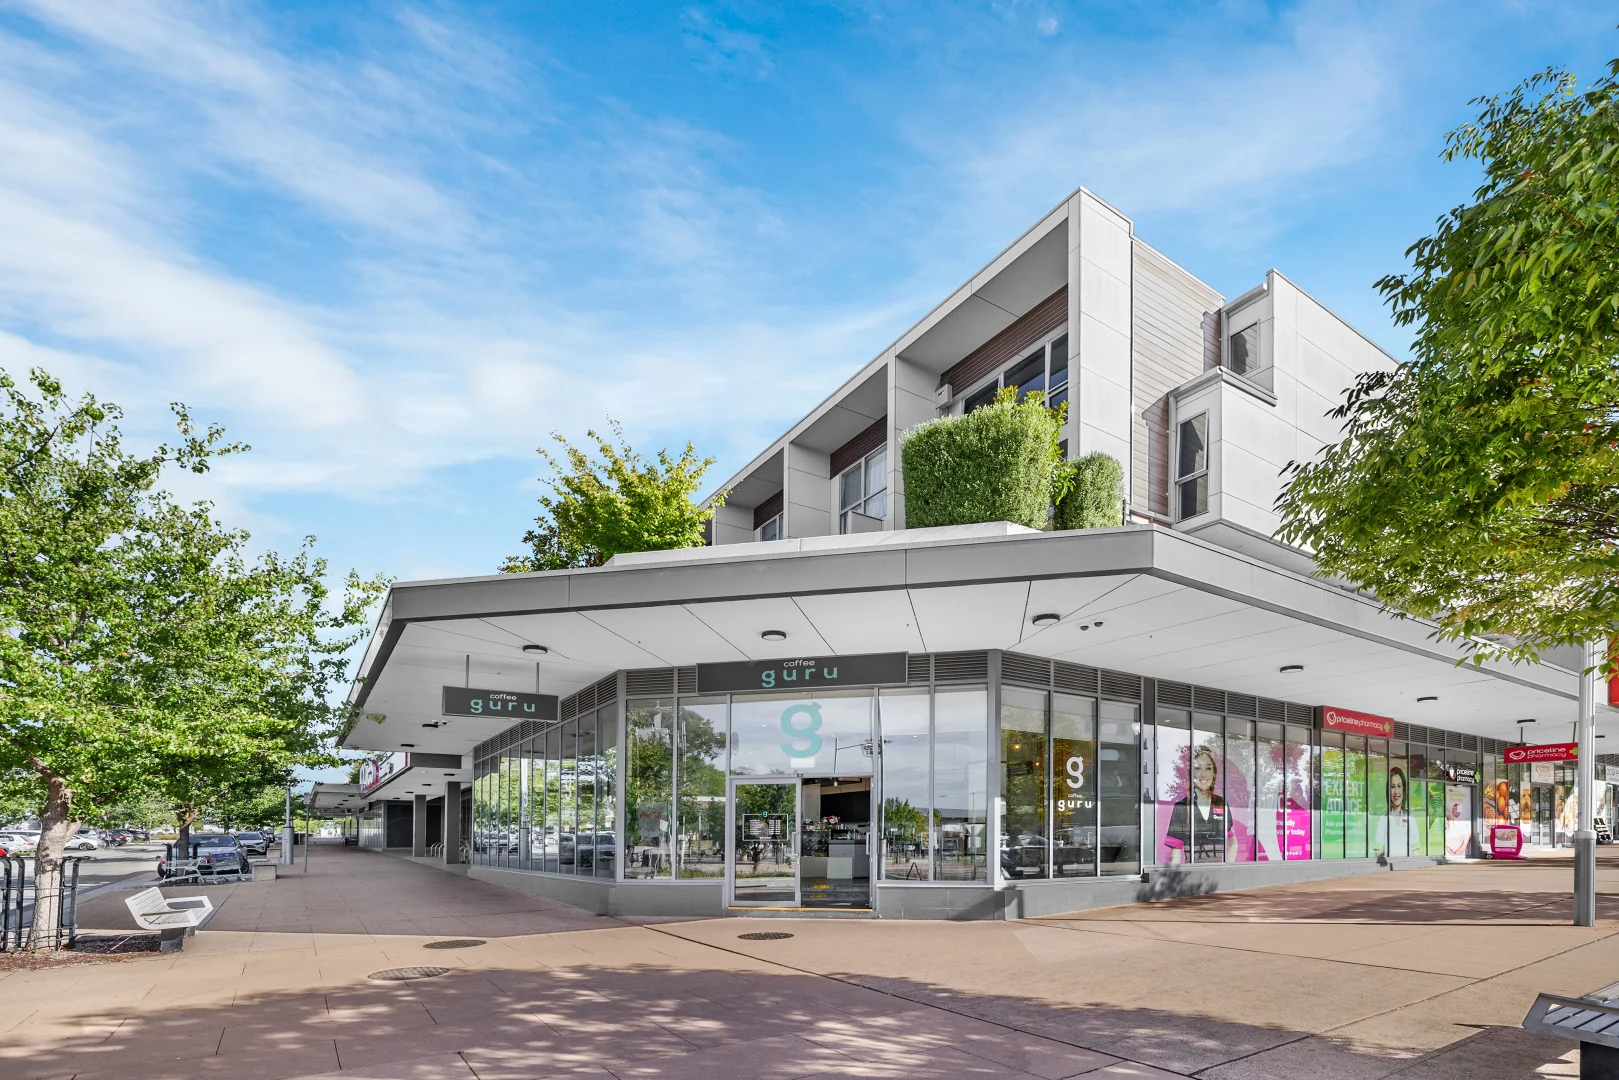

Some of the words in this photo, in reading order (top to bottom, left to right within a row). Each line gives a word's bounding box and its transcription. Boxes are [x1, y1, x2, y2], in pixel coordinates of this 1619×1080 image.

[761, 667, 838, 688] guru
[470, 698, 536, 713] guru
[780, 701, 822, 758] g
[1527, 747, 1566, 755] priceline
[1527, 752, 1567, 760] pharmacy
[1066, 756, 1084, 788] g
[1456, 775, 1475, 783] pharmacy
[1058, 799, 1092, 811] guru
[1290, 828, 1306, 837] today
